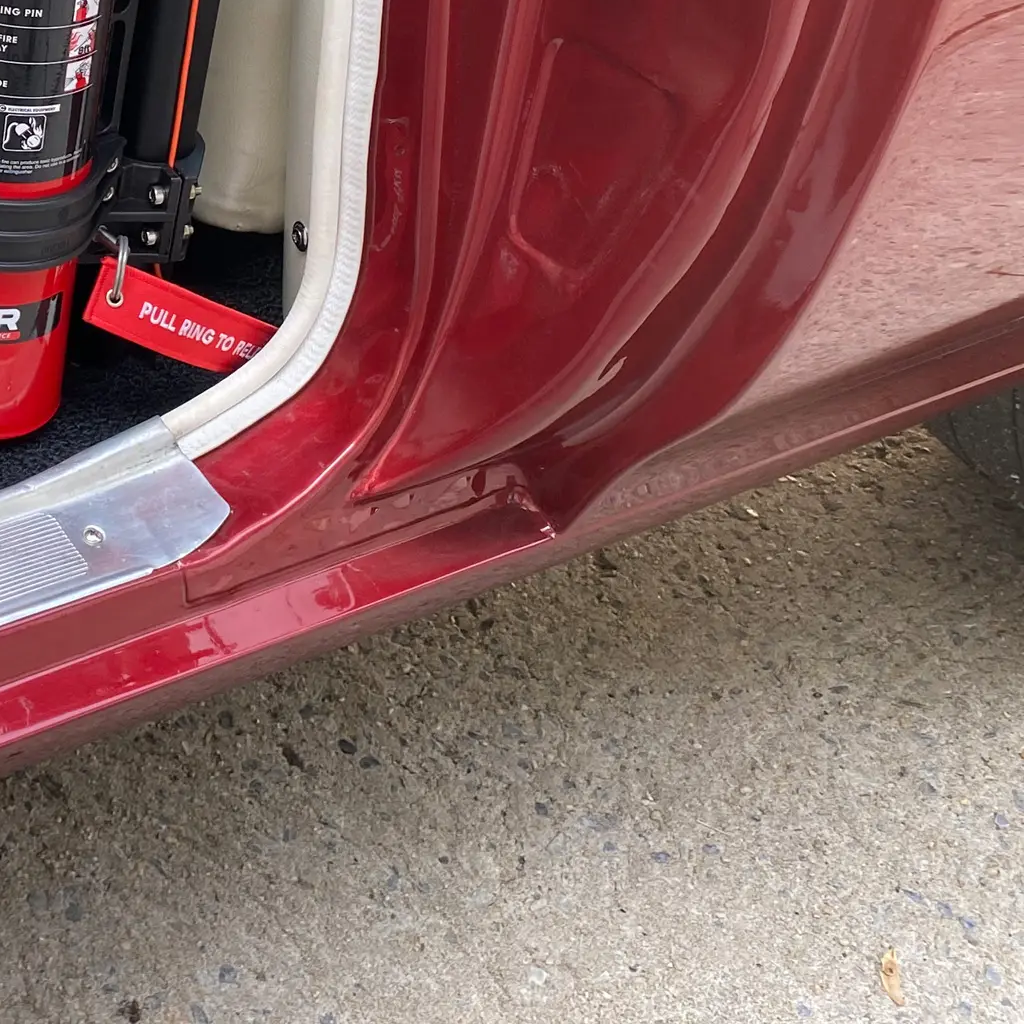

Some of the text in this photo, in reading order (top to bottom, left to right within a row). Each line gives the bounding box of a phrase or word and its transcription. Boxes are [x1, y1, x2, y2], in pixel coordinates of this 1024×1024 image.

[24, 9, 43, 18] PIN
[138, 302, 176, 332] PULL
[178, 318, 215, 346] RING
[215, 332, 235, 351] TO
